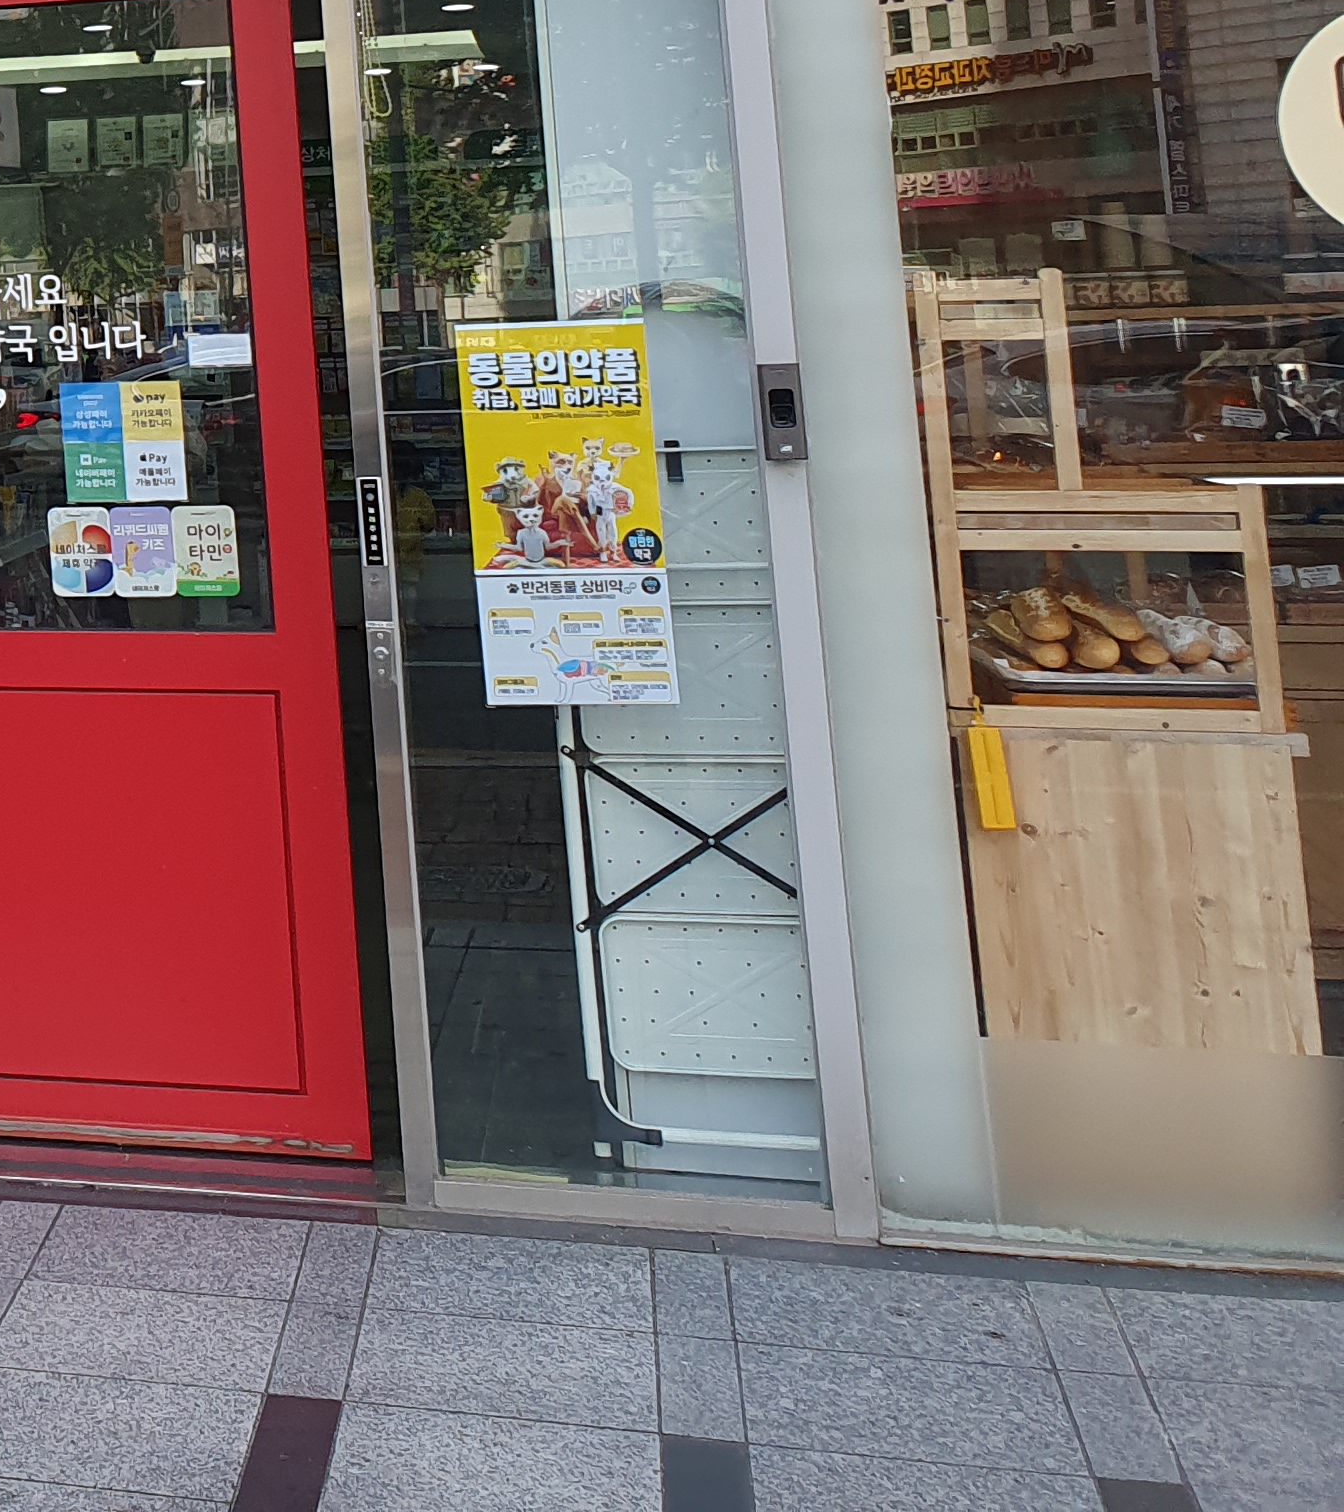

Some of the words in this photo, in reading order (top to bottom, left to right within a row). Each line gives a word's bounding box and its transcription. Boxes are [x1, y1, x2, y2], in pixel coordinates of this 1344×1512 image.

[48, 320, 148, 364] 입니다
[467, 348, 641, 387] 동물의약품
[519, 386, 560, 409] 판매
[562, 383, 641, 407] 허가약국
[186, 523, 222, 541] 마이
[141, 538, 166, 551] 키즈
[189, 543, 224, 562] 타민
[521, 580, 578, 595] 반려동물
[580, 579, 624, 594] 상비약
